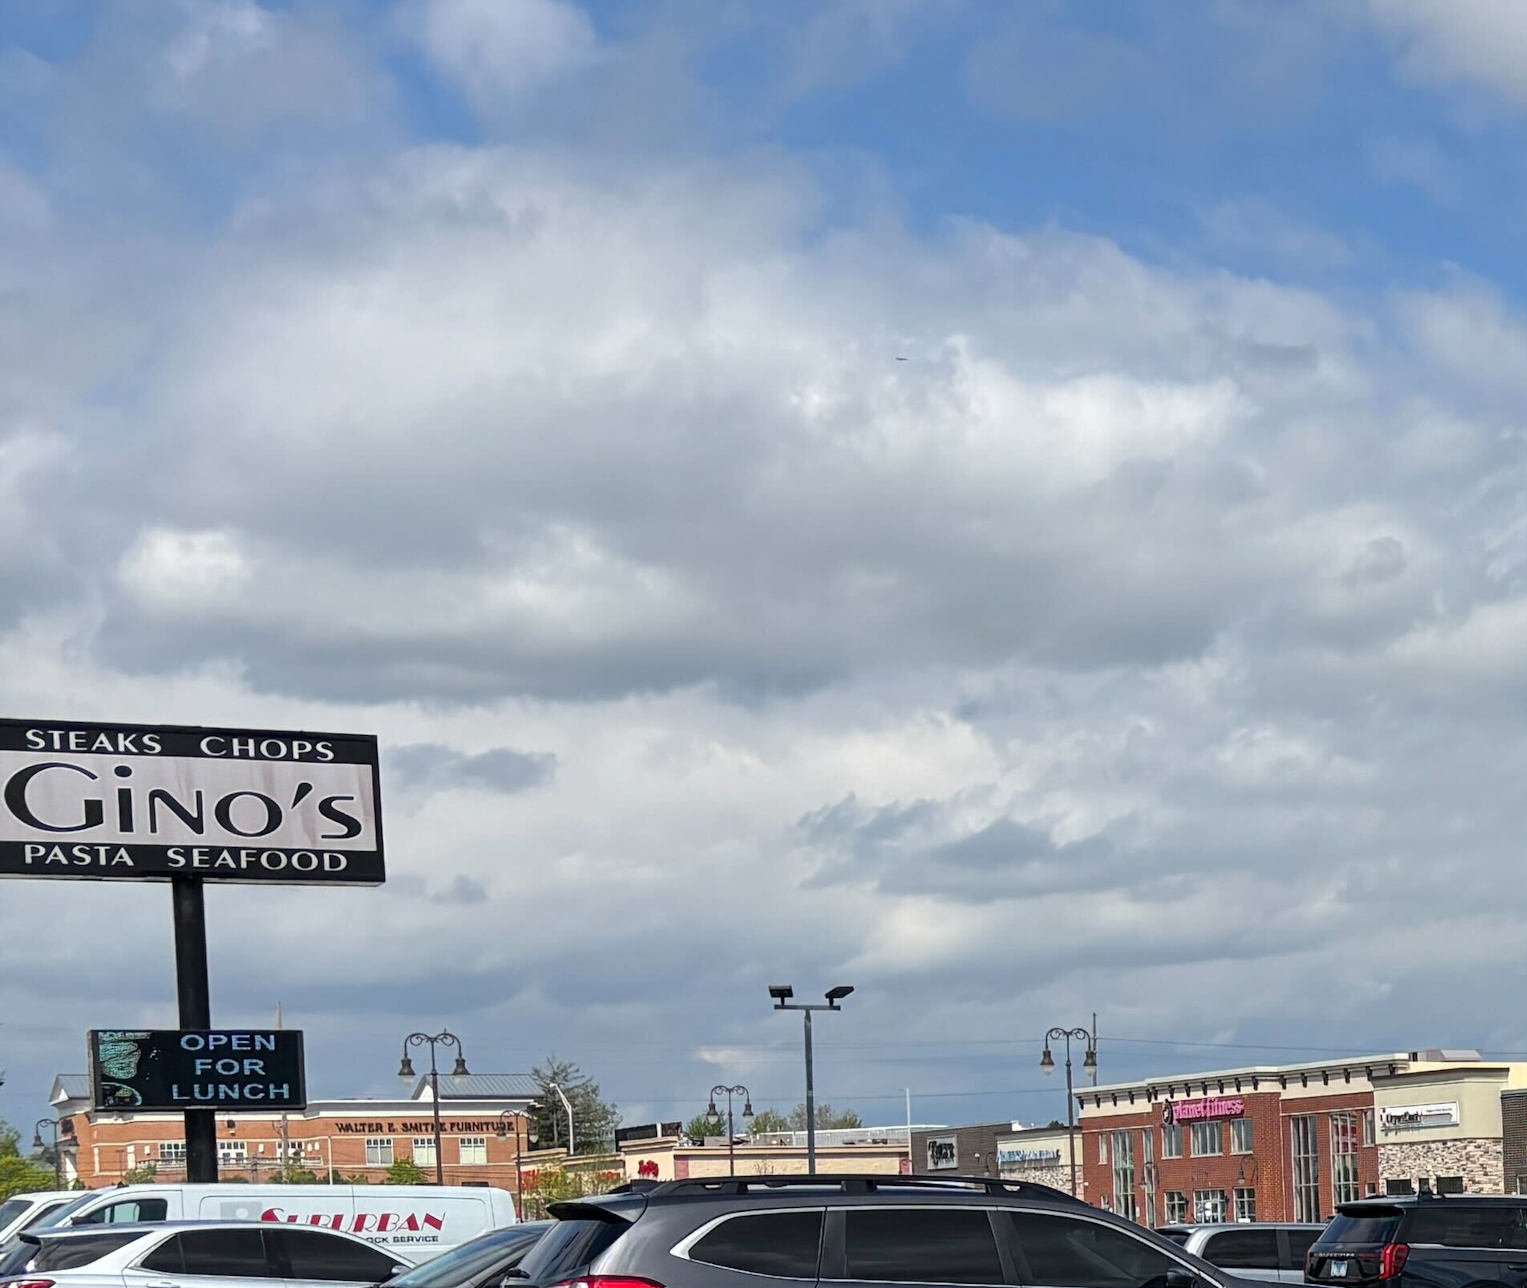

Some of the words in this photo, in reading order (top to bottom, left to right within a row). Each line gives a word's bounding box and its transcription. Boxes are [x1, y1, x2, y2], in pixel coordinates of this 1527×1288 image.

[26, 729, 162, 754] STEAKS
[200, 736, 335, 760] CHOPS
[24, 844, 135, 867] PASTA
[166, 847, 348, 871] SEAFOOD
[180, 1034, 276, 1052] OPEN
[194, 1059, 266, 1076] FOR
[172, 1083, 290, 1100] LUNCH
[335, 1122, 383, 1133] WALTER
[365, 1236, 389, 1244] OCK
[393, 1235, 439, 1244] SERVICE
